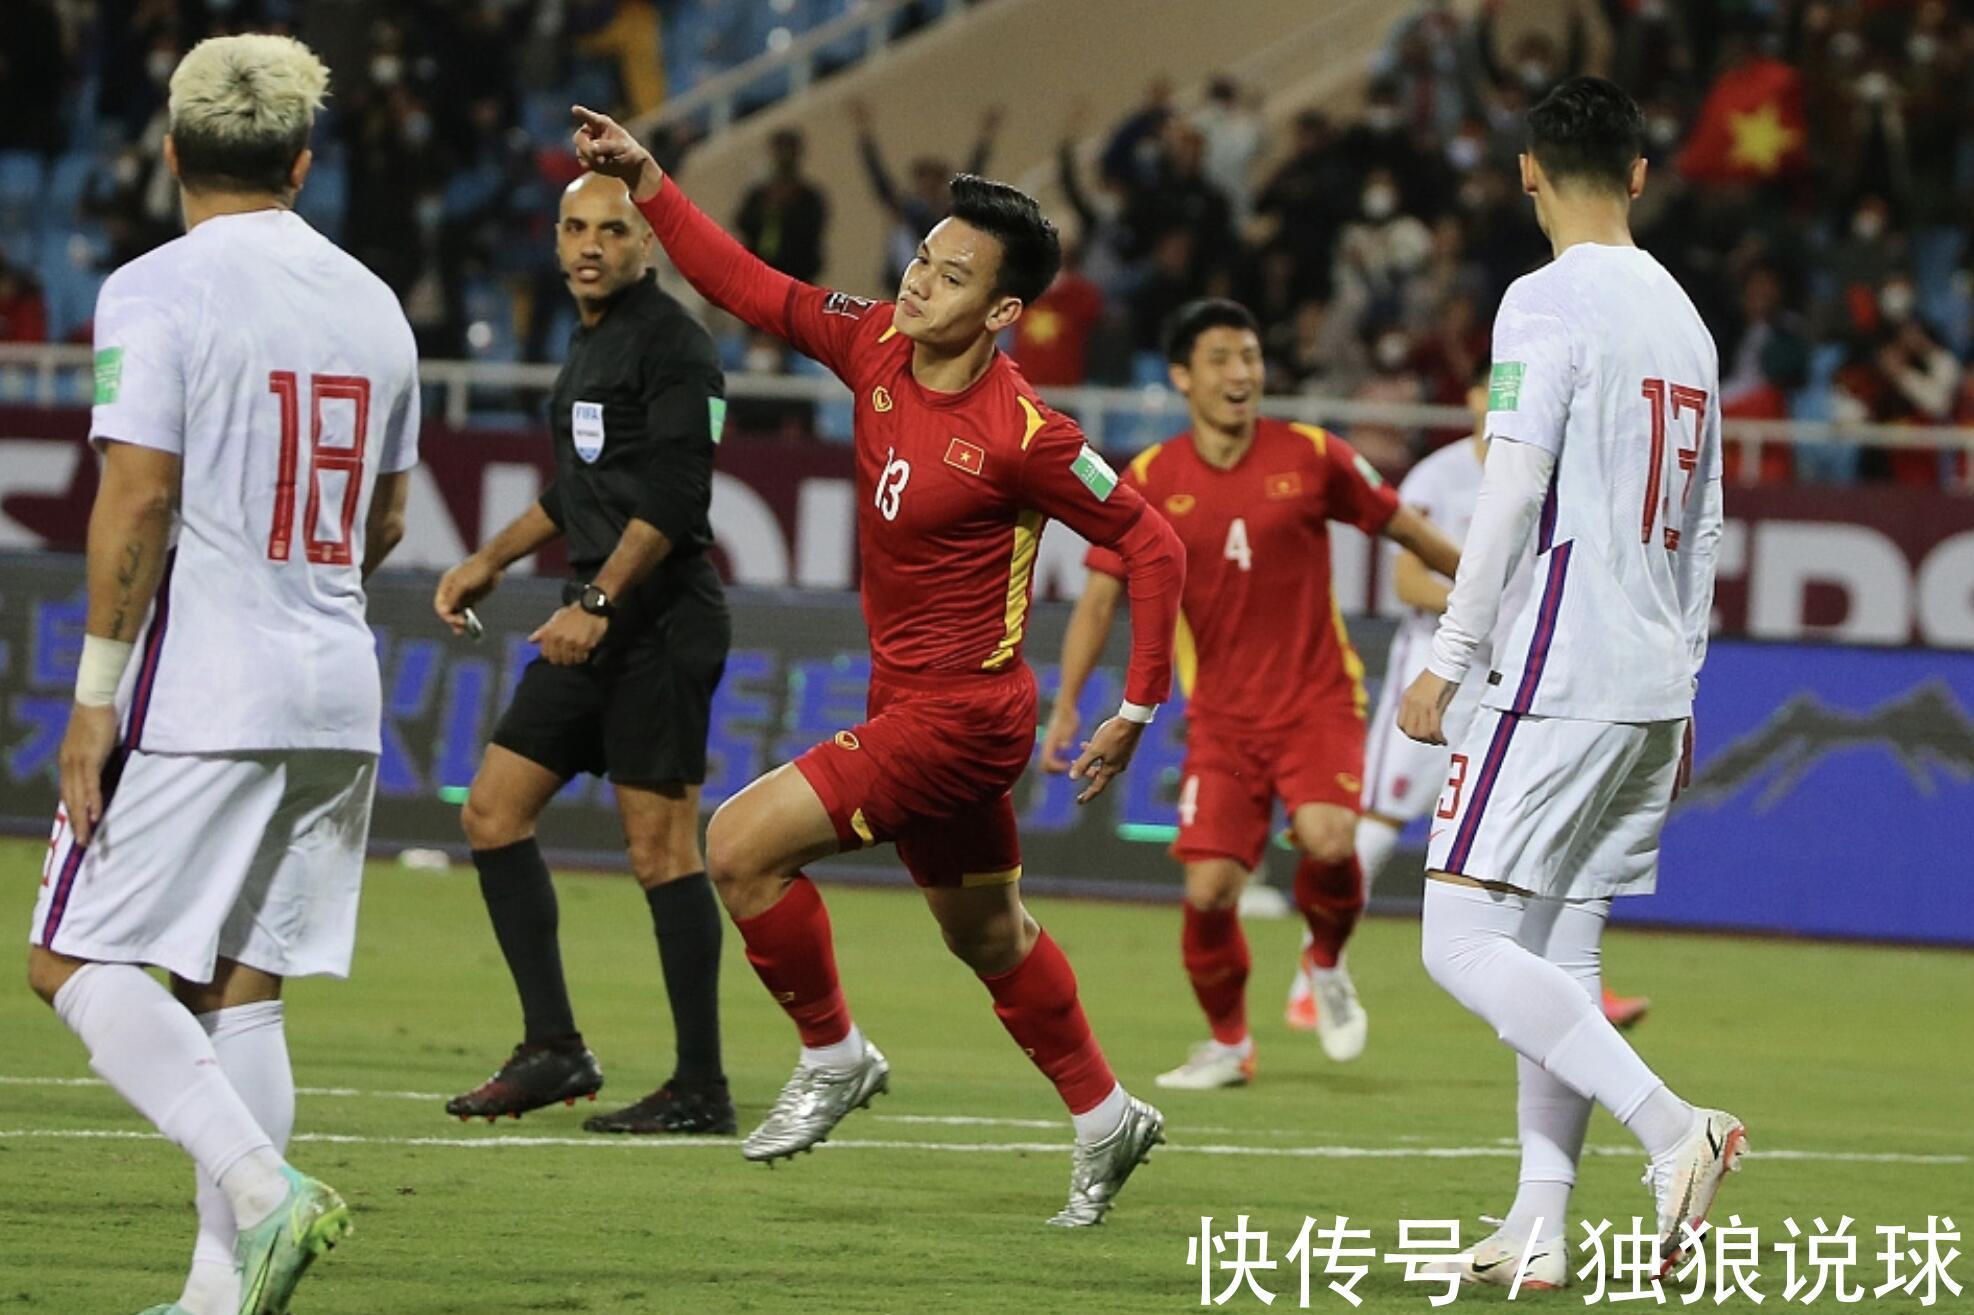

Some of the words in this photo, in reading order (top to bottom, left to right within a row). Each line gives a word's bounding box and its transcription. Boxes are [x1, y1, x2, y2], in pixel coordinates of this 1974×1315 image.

[268, 371, 370, 566] 18
[875, 446, 910, 521] 13
[1641, 378, 1707, 552] 13
[1223, 517, 1252, 572] 4
